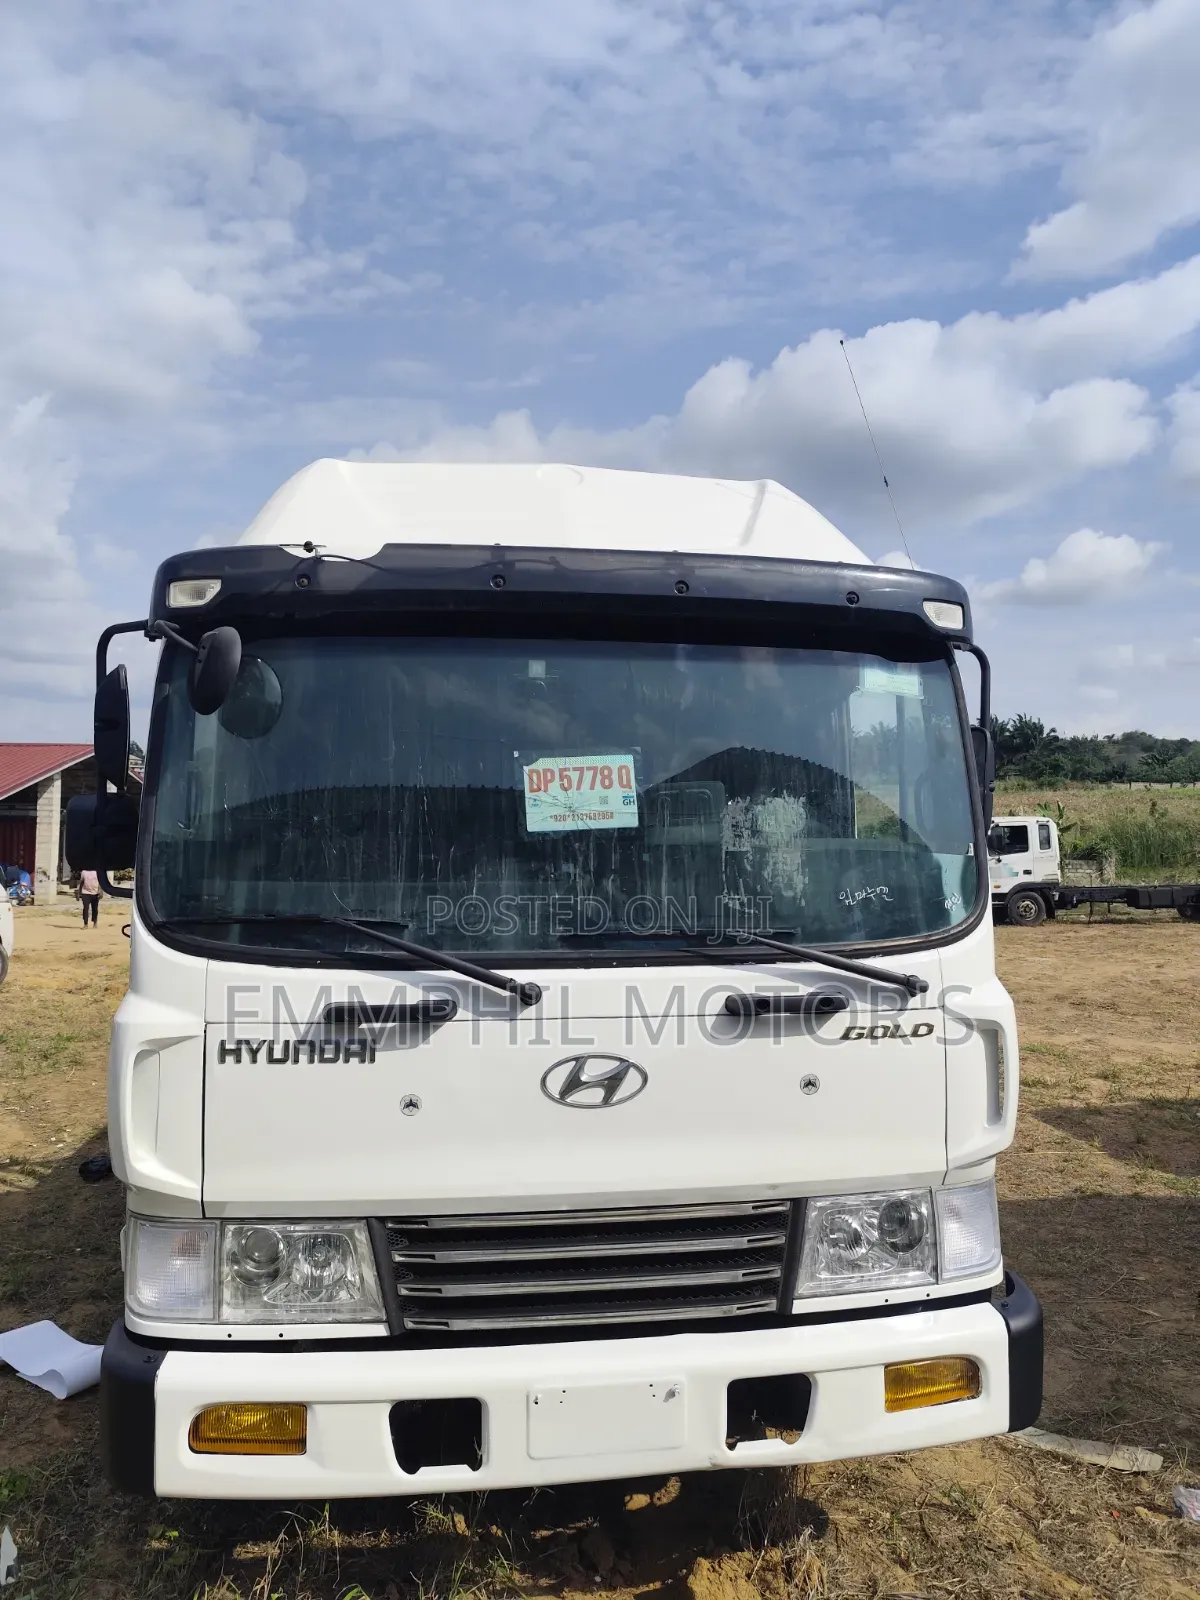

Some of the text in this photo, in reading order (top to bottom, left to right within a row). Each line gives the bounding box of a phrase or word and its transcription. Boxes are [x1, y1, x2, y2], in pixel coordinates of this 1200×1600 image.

[528, 765, 632, 793] DP 5778 Q
[622, 798, 635, 806] GH
[839, 1022, 935, 1041] GOLD
[217, 1039, 377, 1064] HYUNDAI
